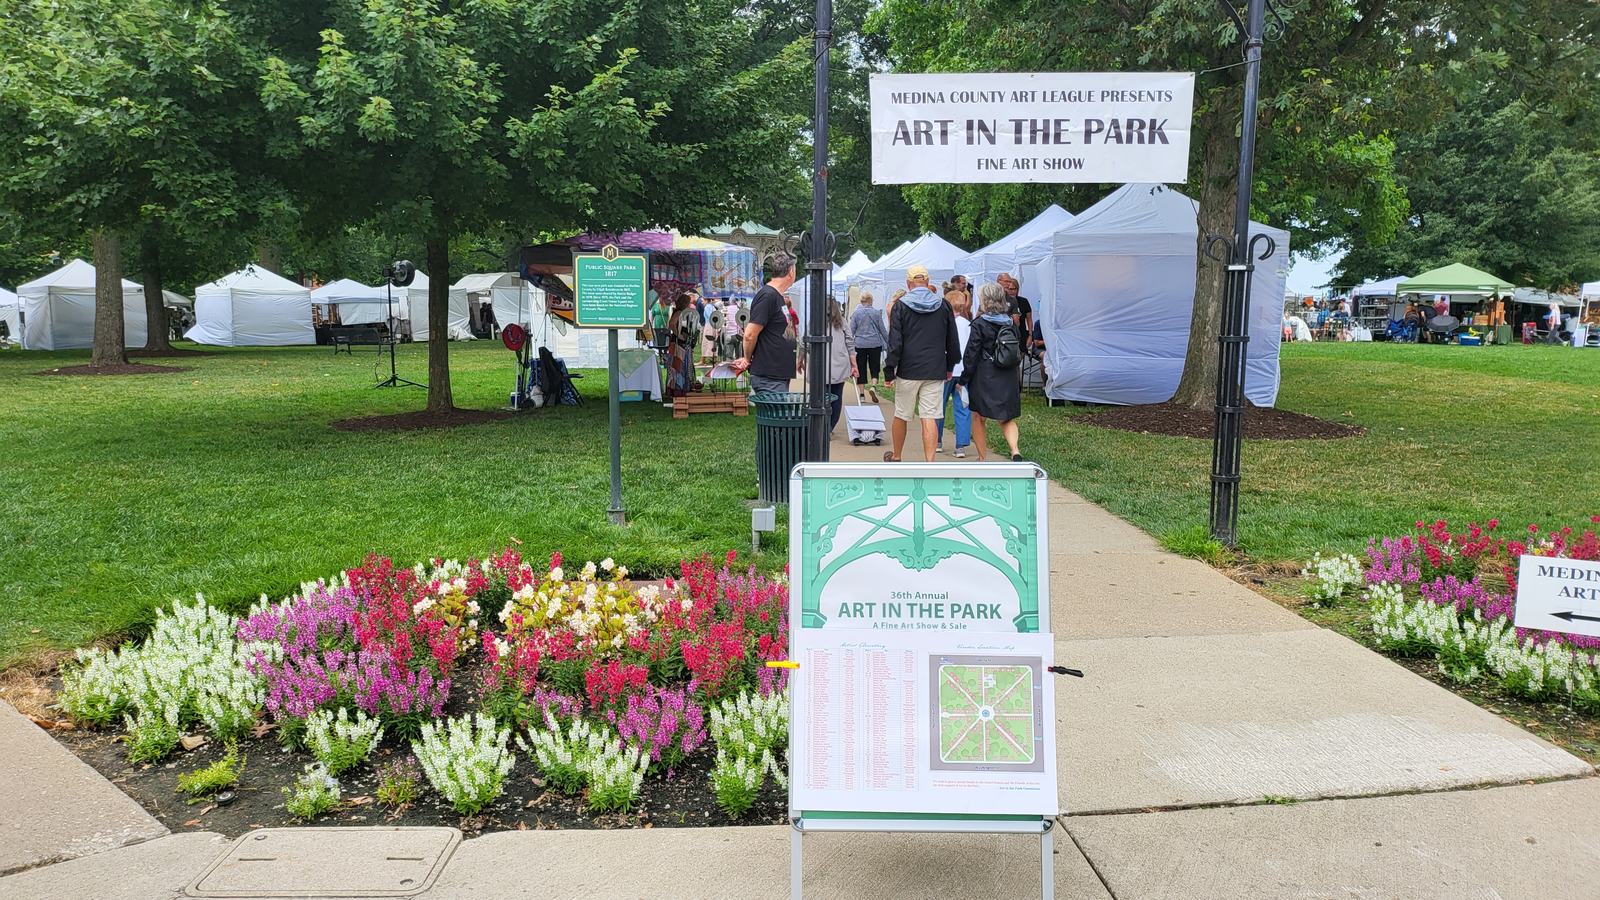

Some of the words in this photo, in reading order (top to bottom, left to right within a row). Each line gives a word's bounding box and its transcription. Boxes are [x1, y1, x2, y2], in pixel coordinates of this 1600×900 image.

[891, 92, 945, 104] MEDINA
[950, 91, 1006, 104] COUNTY
[1010, 91, 1038, 103] ART
[1042, 90, 1096, 103] LEAGUE
[1101, 90, 1173, 103] PRESENTS
[892, 119, 954, 146] ART
[966, 119, 996, 145] IN
[1008, 118, 1071, 145] THE
[1083, 118, 1170, 145] PARK
[977, 158, 1007, 170] FINE
[1012, 158, 1039, 170] ART
[1043, 157, 1085, 170] SHOW
[890, 591, 912, 600] 36th
[914, 591, 949, 600] Annual
[1557, 585, 1600, 601] ART
[838, 602, 876, 618] ART
[882, 602, 901, 618] IN
[906, 603, 945, 619] THE
[950, 603, 1002, 619] PARK
[881, 622, 899, 630] Fine
[901, 622, 915, 630] Art
[916, 622, 939, 630] Show
[949, 622, 967, 630] Sale
